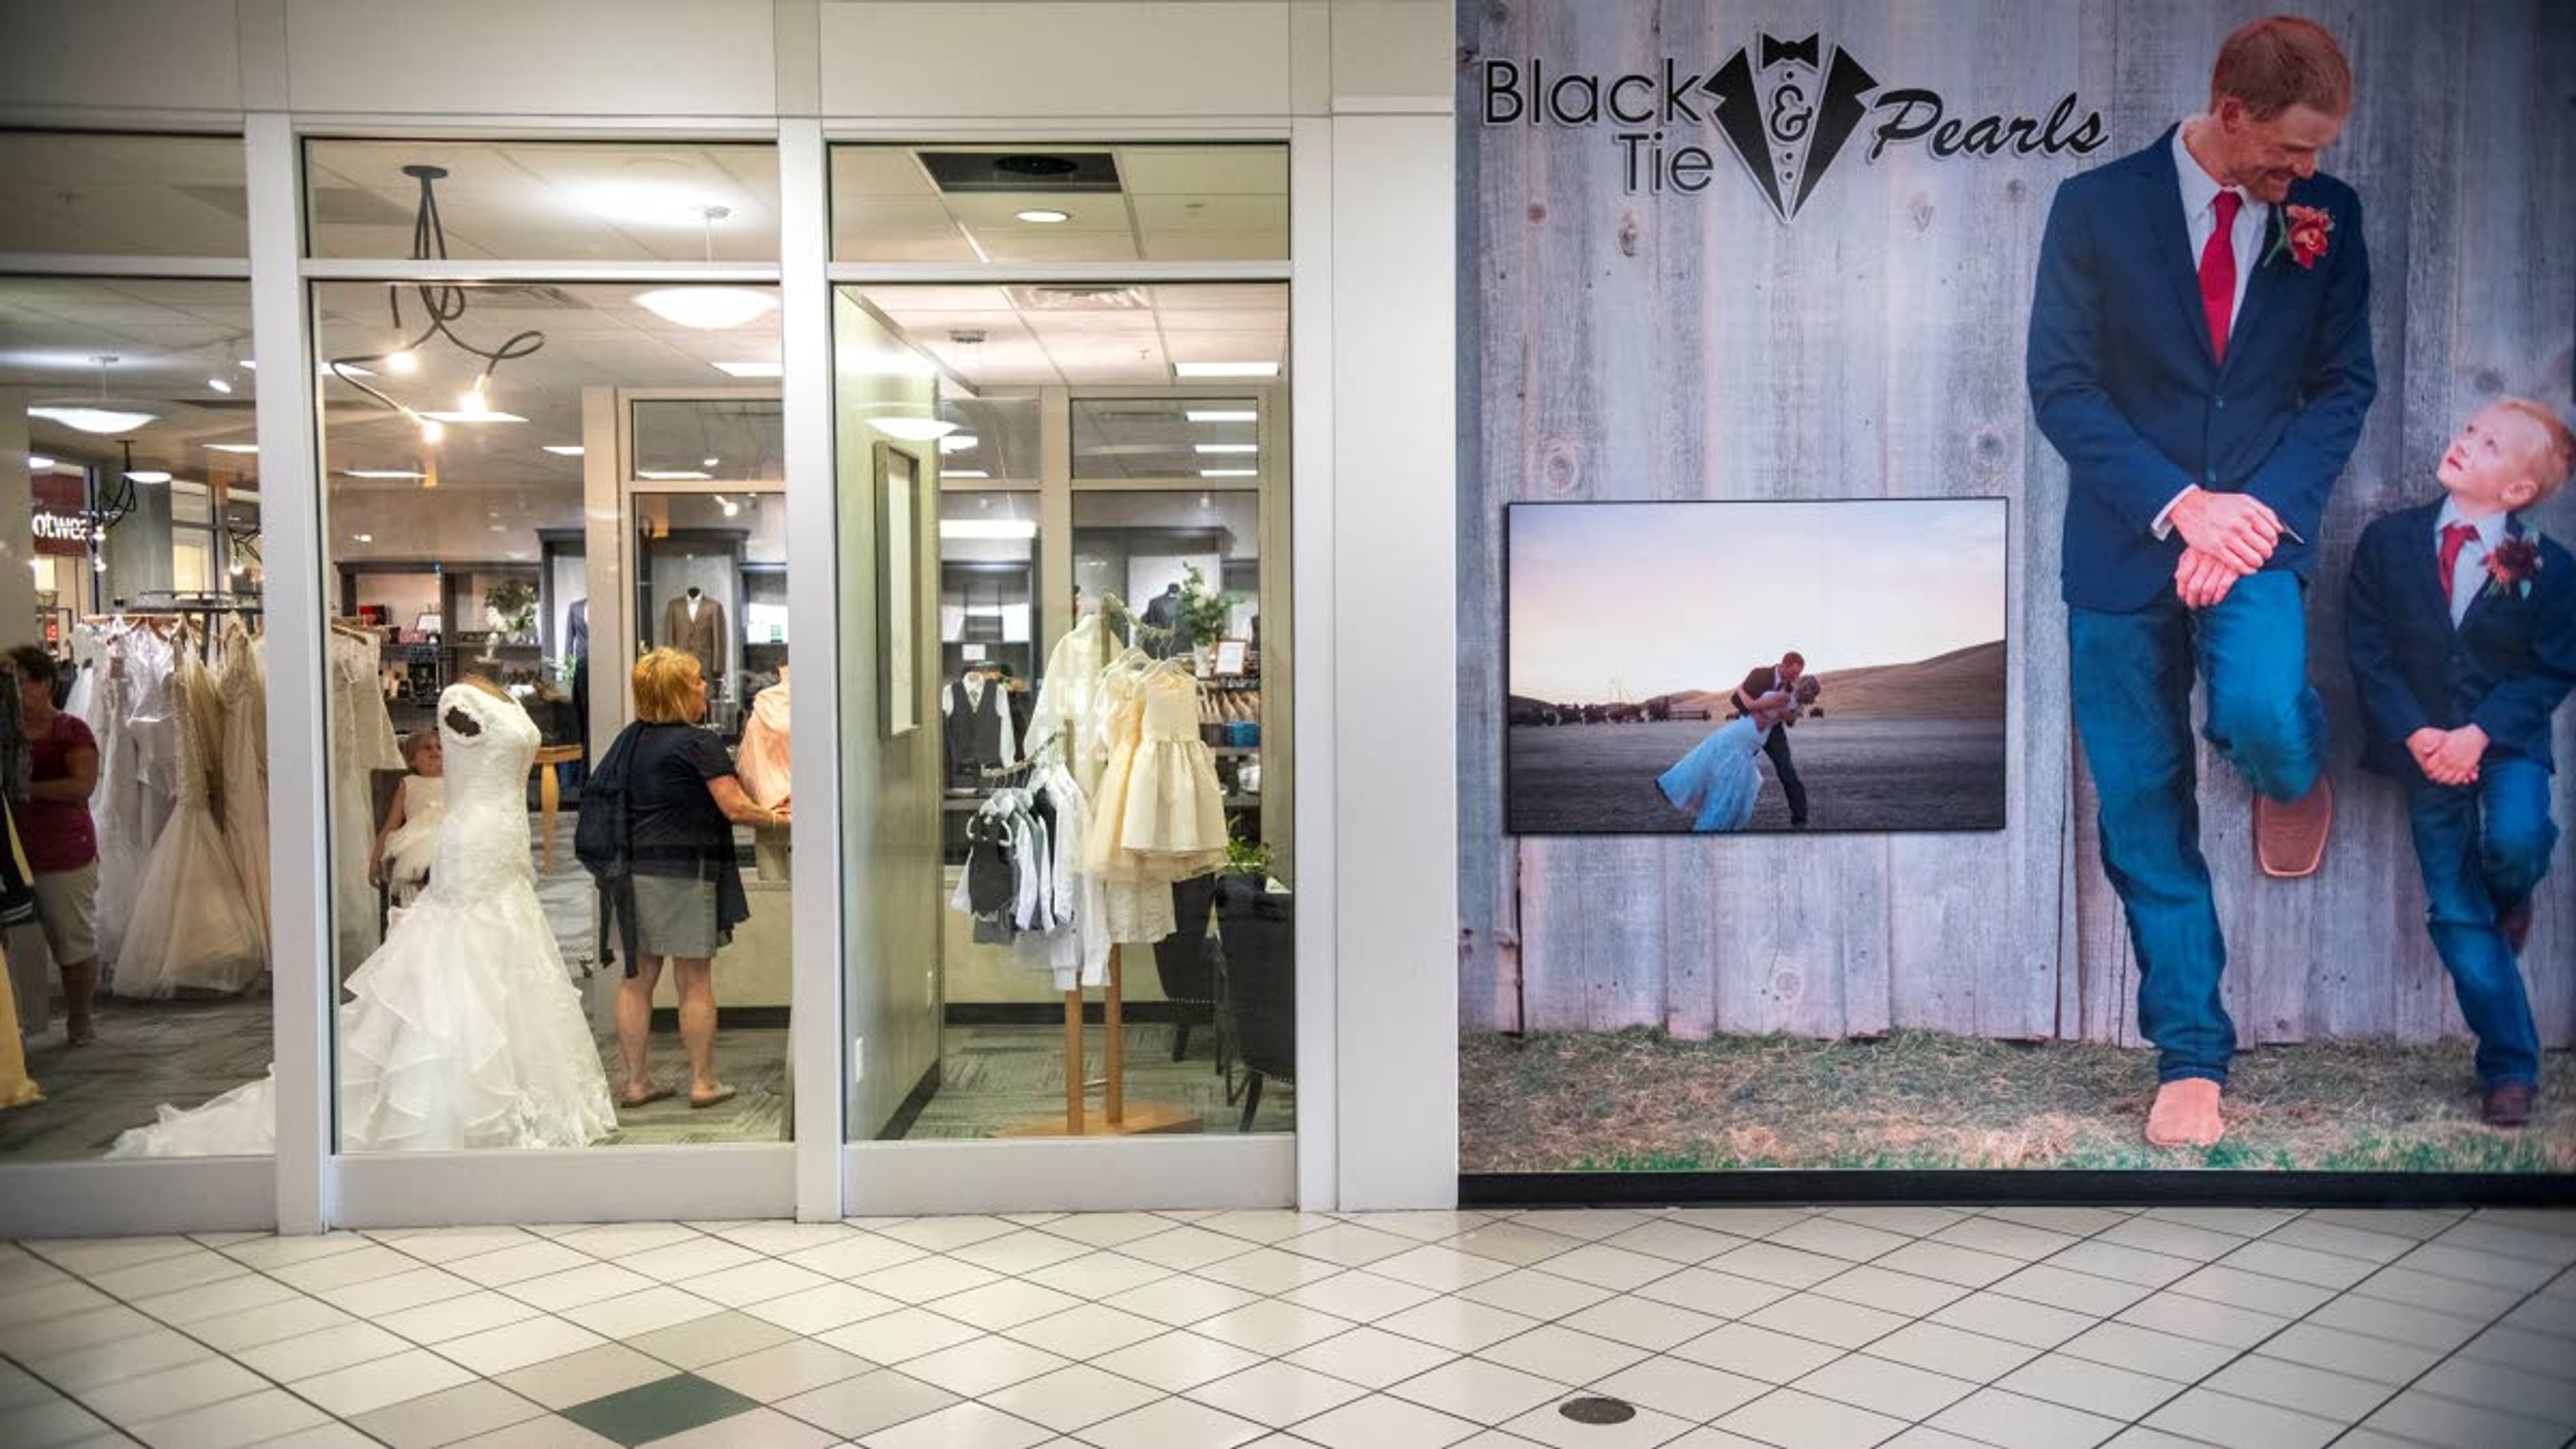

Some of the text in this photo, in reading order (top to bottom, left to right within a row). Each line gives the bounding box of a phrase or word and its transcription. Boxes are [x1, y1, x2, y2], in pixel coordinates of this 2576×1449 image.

[1485, 58, 1703, 124] Black
[1771, 84, 1812, 142] &
[1870, 88, 2110, 160] Pearls
[1617, 131, 1715, 191] Tie
